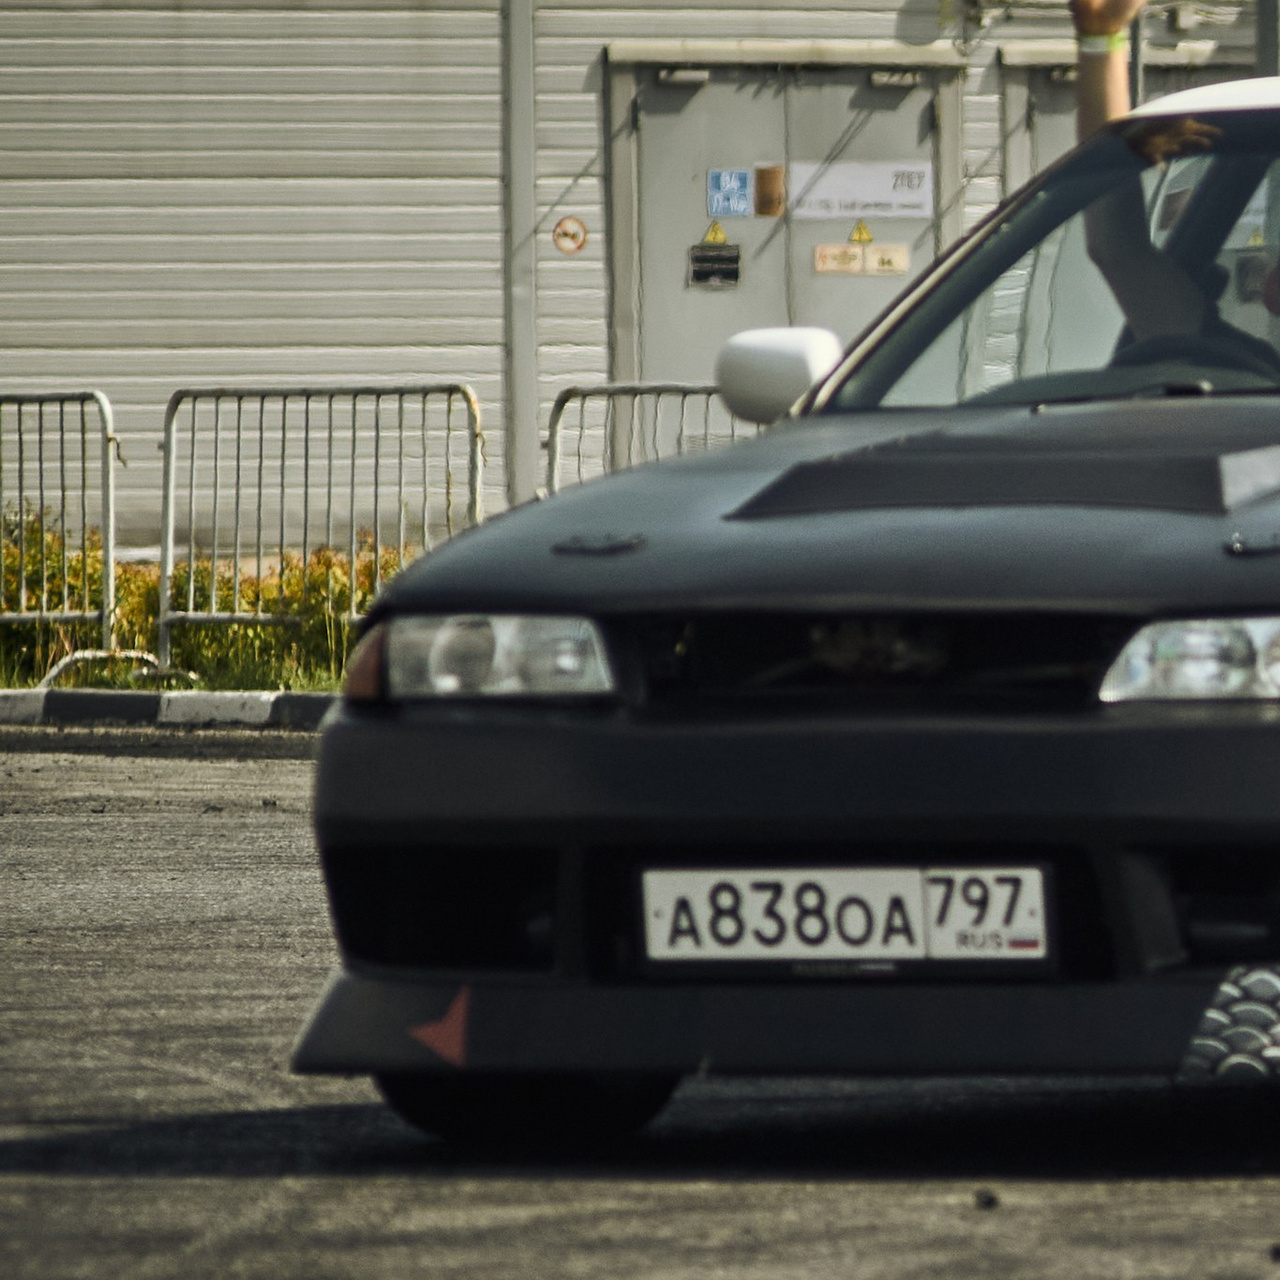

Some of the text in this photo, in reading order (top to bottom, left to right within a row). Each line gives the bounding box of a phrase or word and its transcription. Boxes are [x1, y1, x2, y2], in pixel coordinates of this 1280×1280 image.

[668, 876, 1022, 947] А838ОА 797
[955, 931, 1004, 951] RUS
